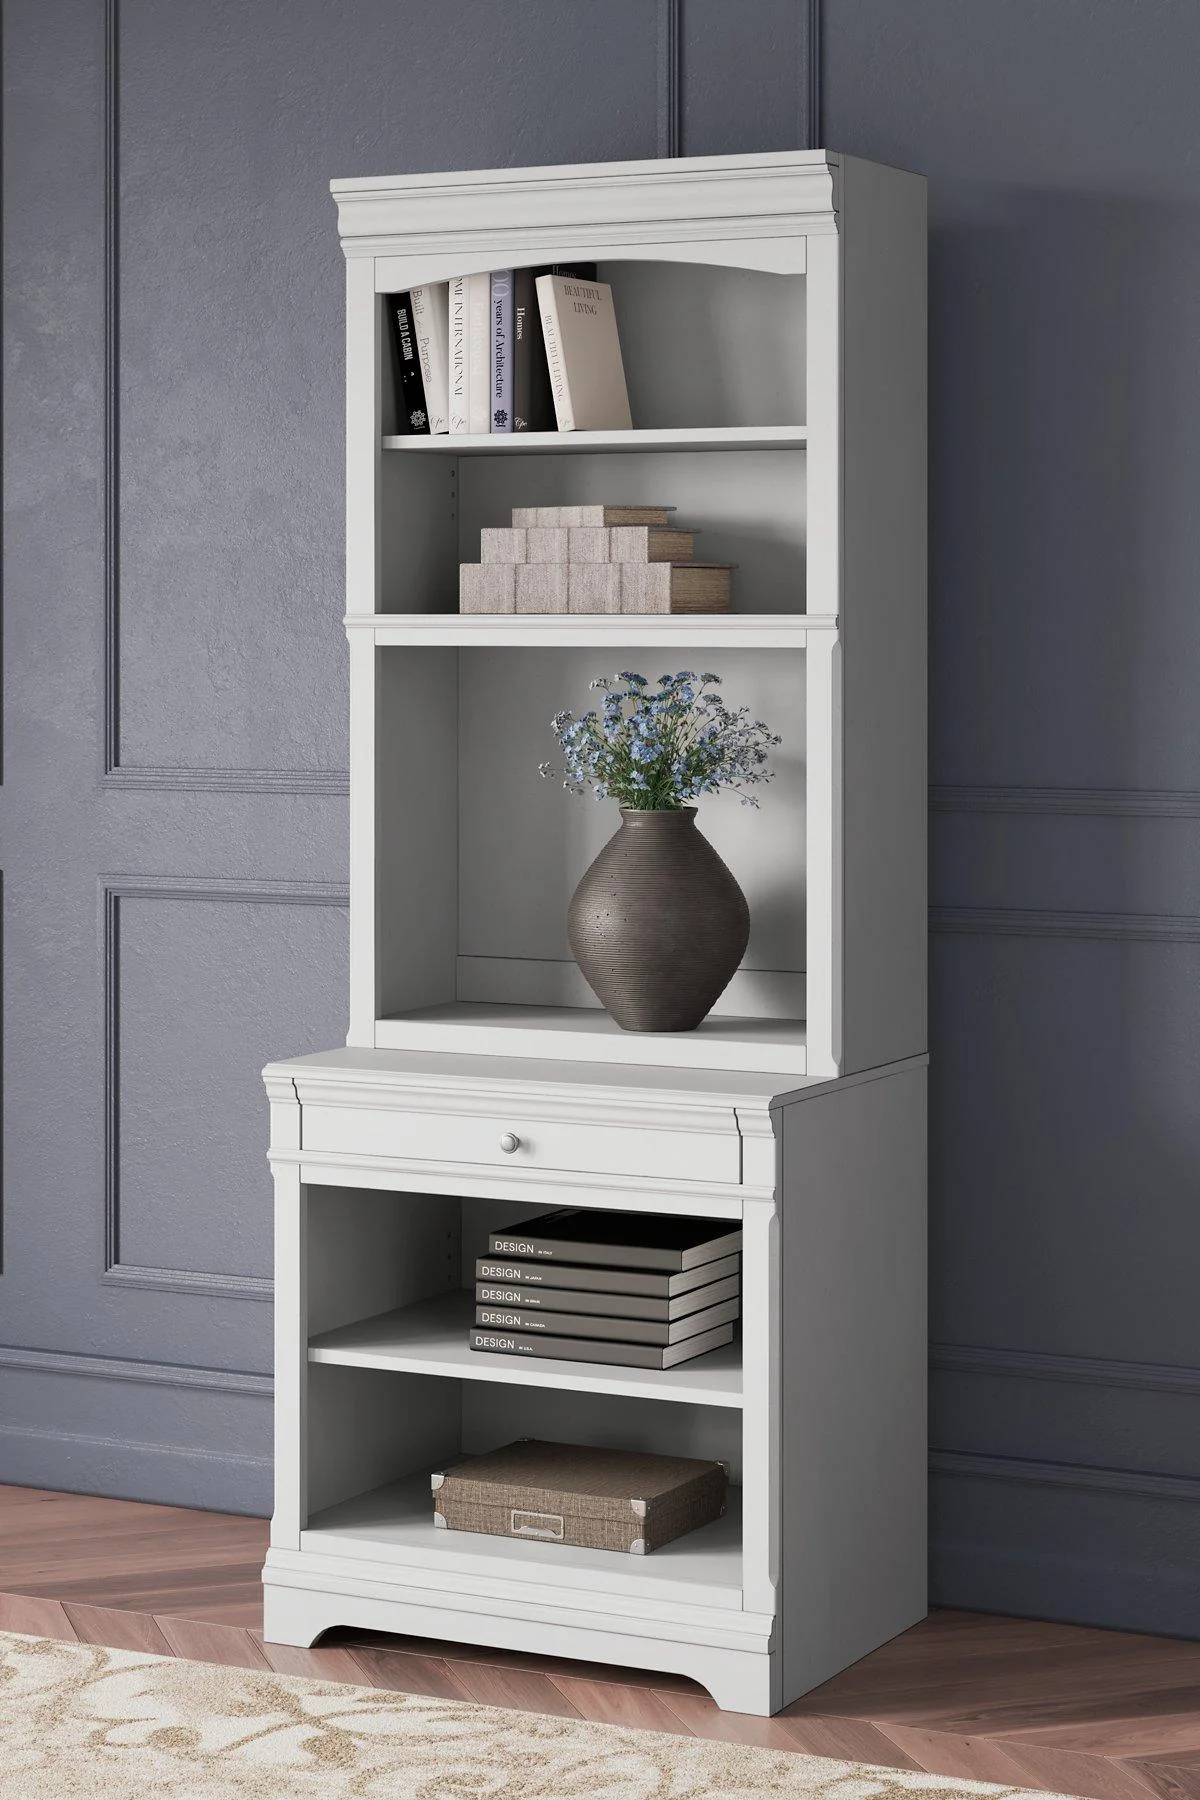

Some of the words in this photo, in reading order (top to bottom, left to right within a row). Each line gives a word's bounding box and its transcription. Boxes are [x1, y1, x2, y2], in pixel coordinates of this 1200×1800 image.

[564, 284, 602, 301] BEAUTIFUL
[493, 298, 503, 326] years
[573, 302, 597, 316] LIVING
[397, 308, 409, 331] BUILD
[516, 307, 526, 340] Homes
[413, 290, 424, 315] Built
[420, 337, 432, 383] Purpose
[496, 327, 505, 339] of
[401, 337, 414, 361] CABIN
[454, 302, 463, 395] INTERNATIONAL
[495, 340, 506, 398] Architecture
[494, 1241, 534, 1254] DESIGN
[481, 1266, 521, 1279] DESIGN
[481, 1289, 521, 1302] DESIGN
[481, 1312, 521, 1325] DESIGN
[475, 1336, 515, 1349] DESIGN
